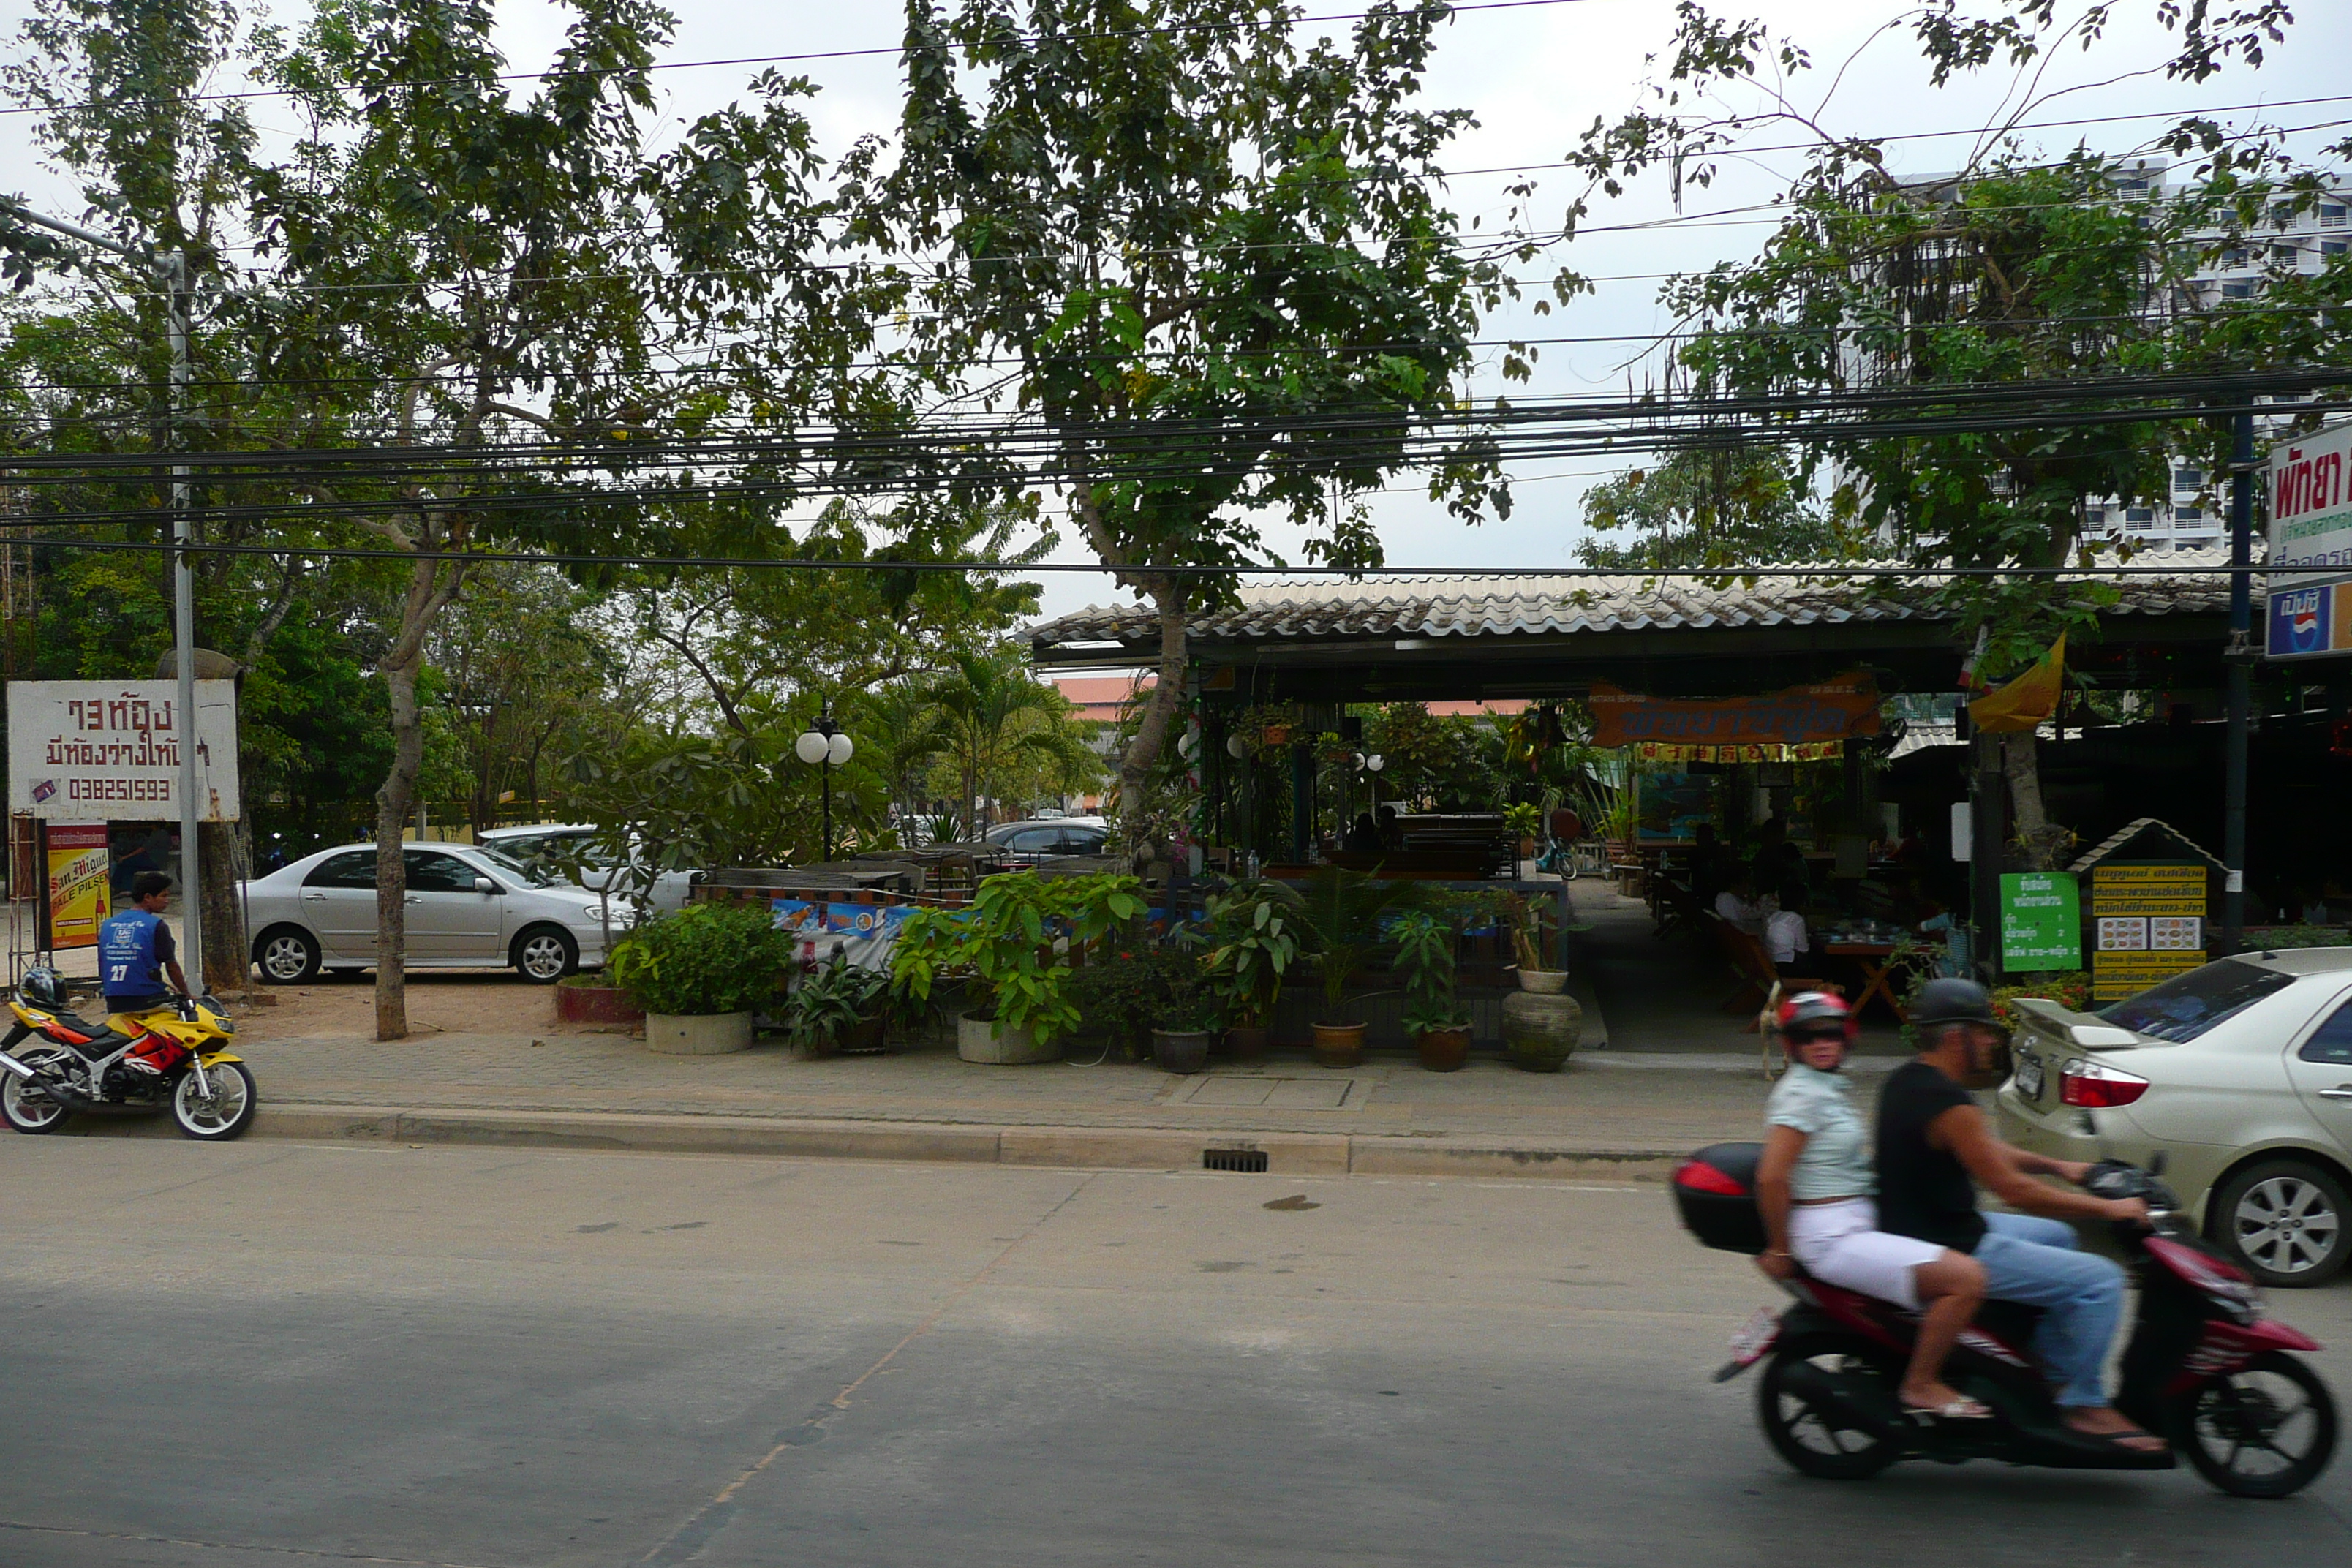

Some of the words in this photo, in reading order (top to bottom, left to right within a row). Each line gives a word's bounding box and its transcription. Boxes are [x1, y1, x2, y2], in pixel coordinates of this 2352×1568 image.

[2276, 448, 2340, 519] พัทยา
[69, 779, 170, 800] 038251593
[50, 872, 72, 894] San
[73, 849, 108, 882] Miguel
[52, 889, 77, 909] PALE
[2058, 929, 2065, 937] 2
[2073, 947, 2079, 955] 2
[110, 965, 128, 981] 27
